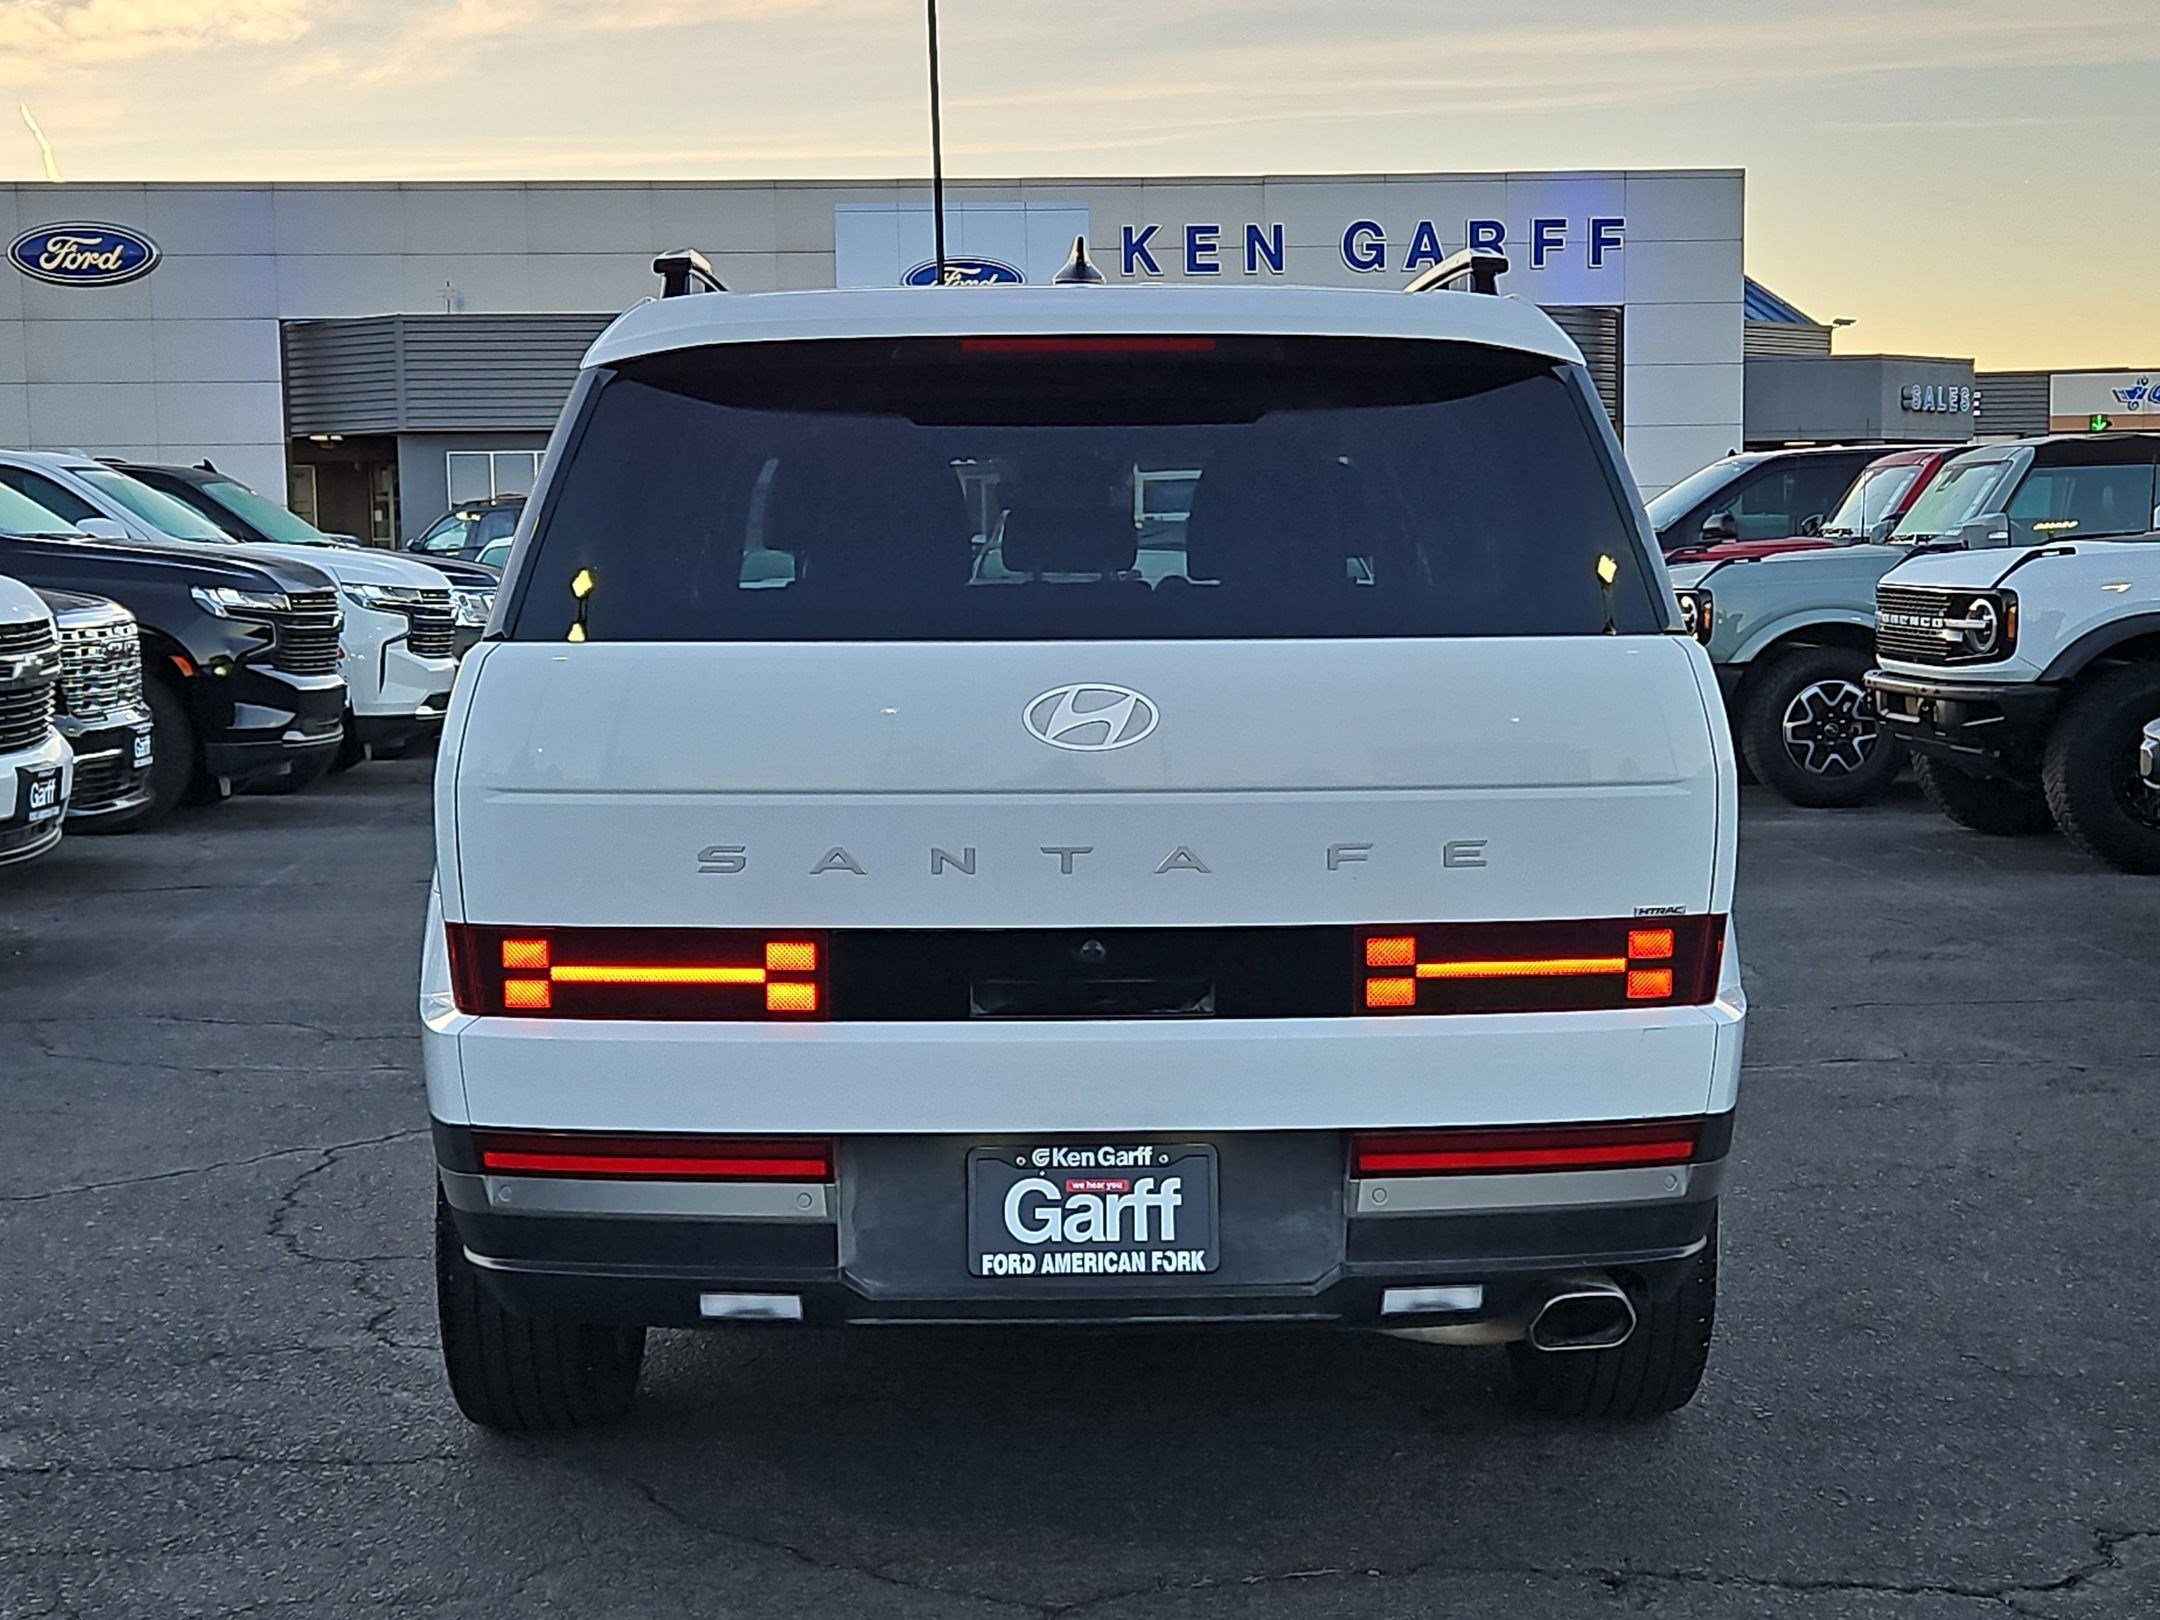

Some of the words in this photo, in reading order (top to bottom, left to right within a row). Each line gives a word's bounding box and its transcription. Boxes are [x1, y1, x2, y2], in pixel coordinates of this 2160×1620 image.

[39, 235, 124, 270] Ford
[1120, 222, 1286, 276] KEN
[1340, 215, 1627, 274] GARFF
[1911, 384, 1971, 413] SALES
[697, 845, 1213, 876] SANTA
[1326, 839, 1489, 871] FE
[1638, 905, 1685, 916] HTRAC
[1052, 1147, 1095, 1168] Ken
[1097, 1146, 1153, 1167] Garff
[1086, 1180, 1105, 1189] hear
[1106, 1182, 1123, 1191] you
[1004, 1177, 1183, 1244] Garff
[982, 1254, 1036, 1275] FORD
[1041, 1251, 1146, 1274] AMERICAN
[1151, 1250, 1206, 1272] FORK
